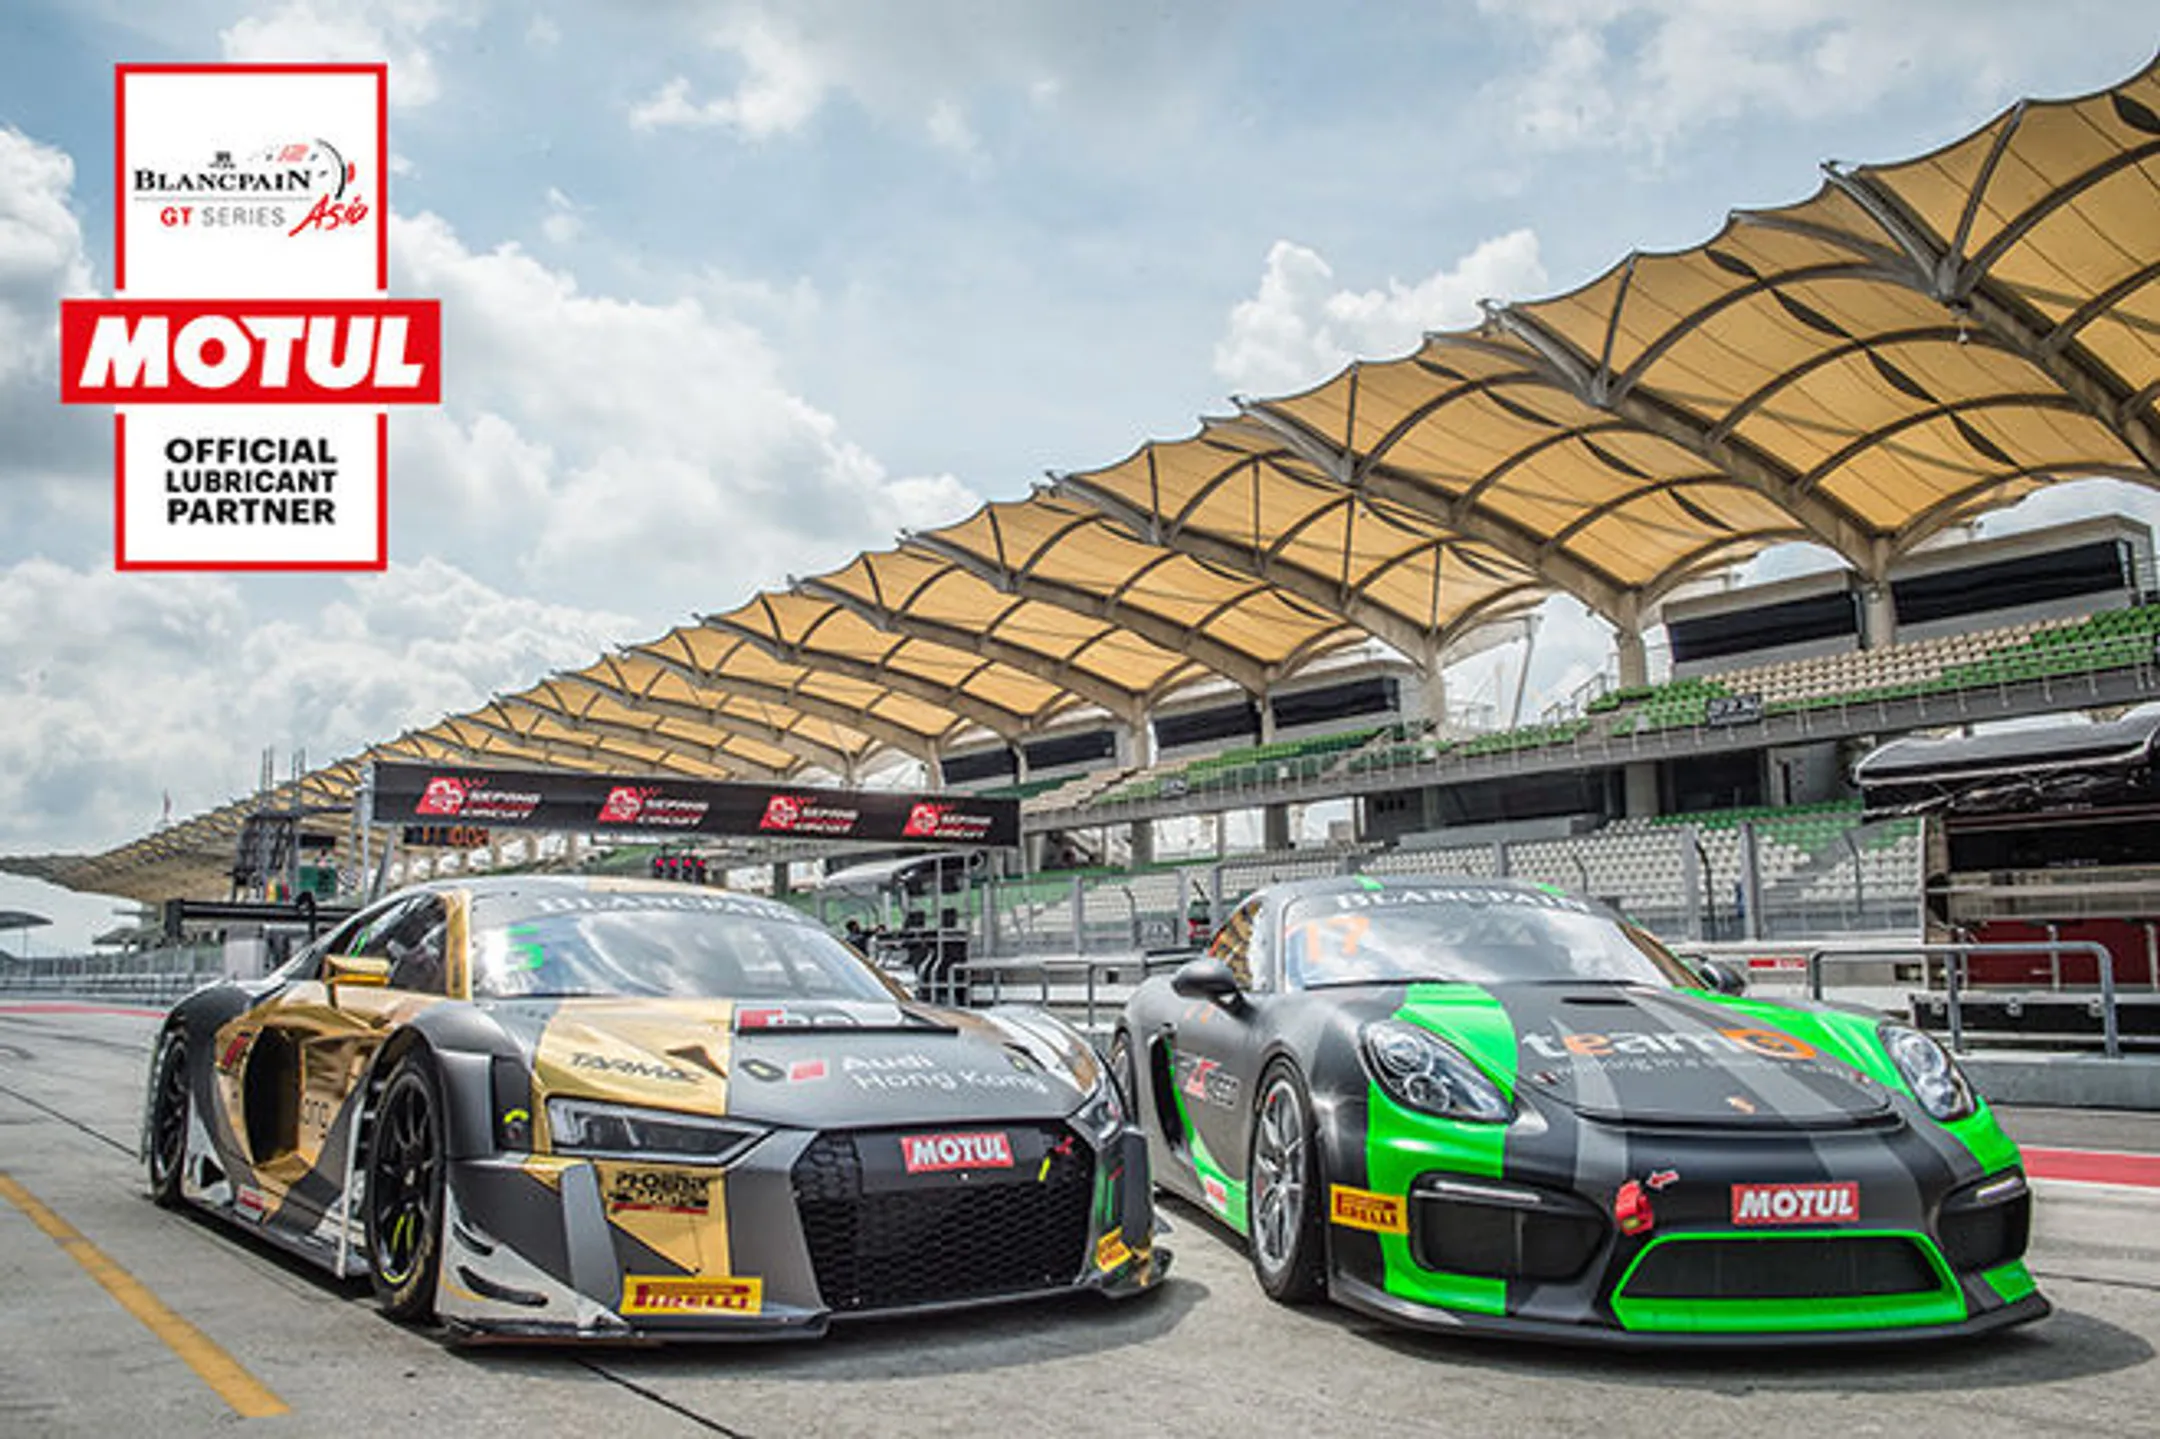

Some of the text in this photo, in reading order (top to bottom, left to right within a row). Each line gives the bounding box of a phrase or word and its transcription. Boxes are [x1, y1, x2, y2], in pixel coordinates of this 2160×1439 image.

[1306, 916, 1370, 964] 17
[842, 1052, 934, 1072] Audi
[912, 1138, 1008, 1165] MOTUL
[1739, 1190, 1854, 1218] MOTUL
[634, 1284, 750, 1309] PIRELLI
